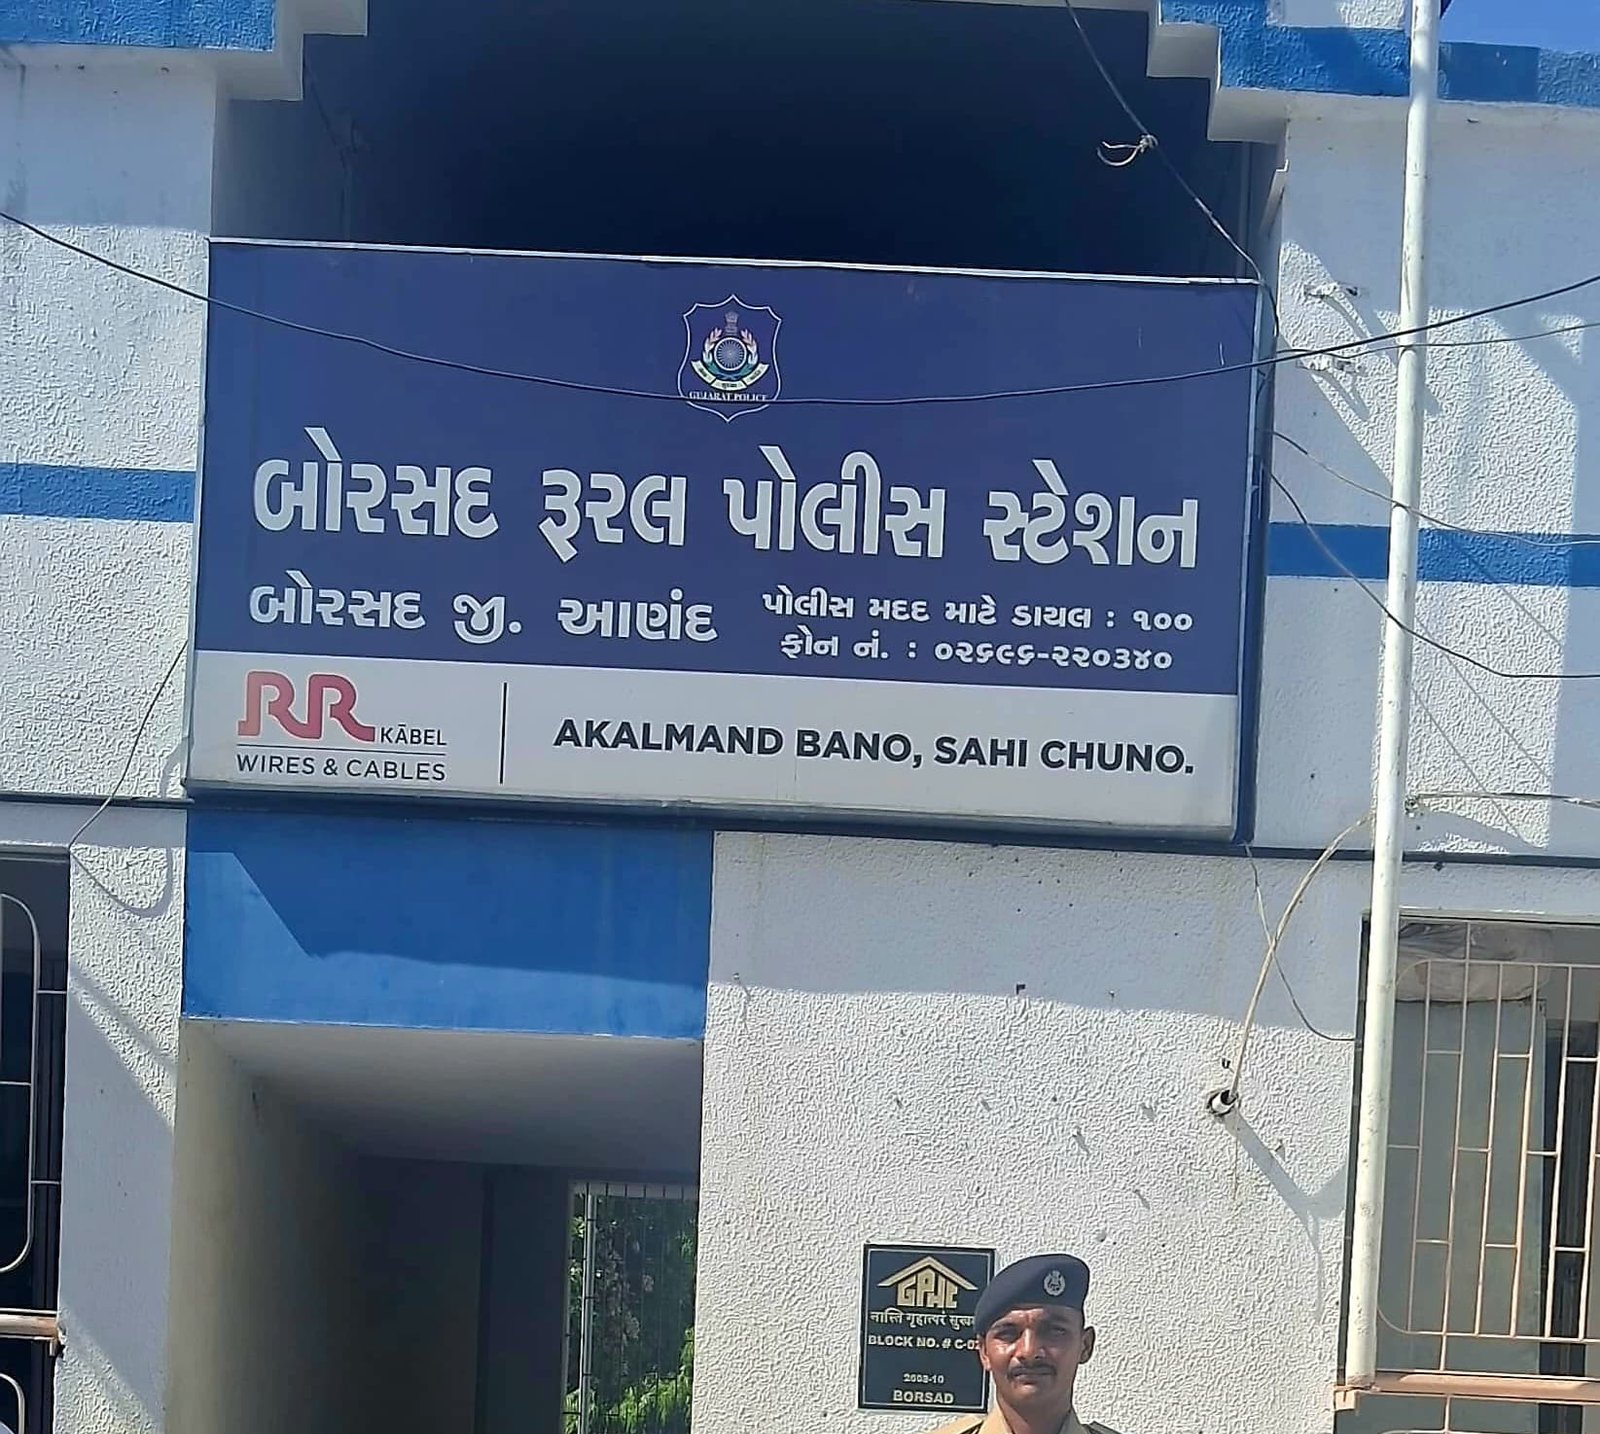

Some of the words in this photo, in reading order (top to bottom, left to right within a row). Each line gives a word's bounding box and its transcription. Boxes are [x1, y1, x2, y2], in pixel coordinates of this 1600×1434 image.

[689, 391, 733, 401] GUJARAT
[734, 393, 767, 402] POLICE
[254, 427, 498, 538] બોરસદ
[539, 470, 686, 562] રૂરલ
[724, 446, 945, 557] પોલીસ
[984, 460, 1198, 567] સ્ટેશન
[250, 570, 425, 628] બોરસદ
[454, 595, 521, 643] જી.
[558, 589, 717, 641] આણંદ
[763, 585, 853, 617] પોલીસ
[869, 599, 929, 621] મદદ
[946, 595, 996, 624] માટે
[1012, 606, 1091, 628] ડાયલ
[1134, 611, 1192, 630] ૧૦૦
[781, 625, 838, 658] ફોન
[854, 630, 888, 658] નં.
[238, 671, 375, 743] RR
[553, 719, 783, 754] AKALMAND
[797, 730, 921, 768] BANO,
[934, 737, 1027, 767] SAHI
[1041, 741, 1193, 773] CHUNO.
[237, 754, 314, 774] WIRES
[324, 759, 338, 775] &
[347, 760, 445, 780] CABLES
[868, 1335, 913, 1347] BLOCK
[916, 1337, 940, 1348] NO.
[893, 1389, 954, 1404] BORSAD
